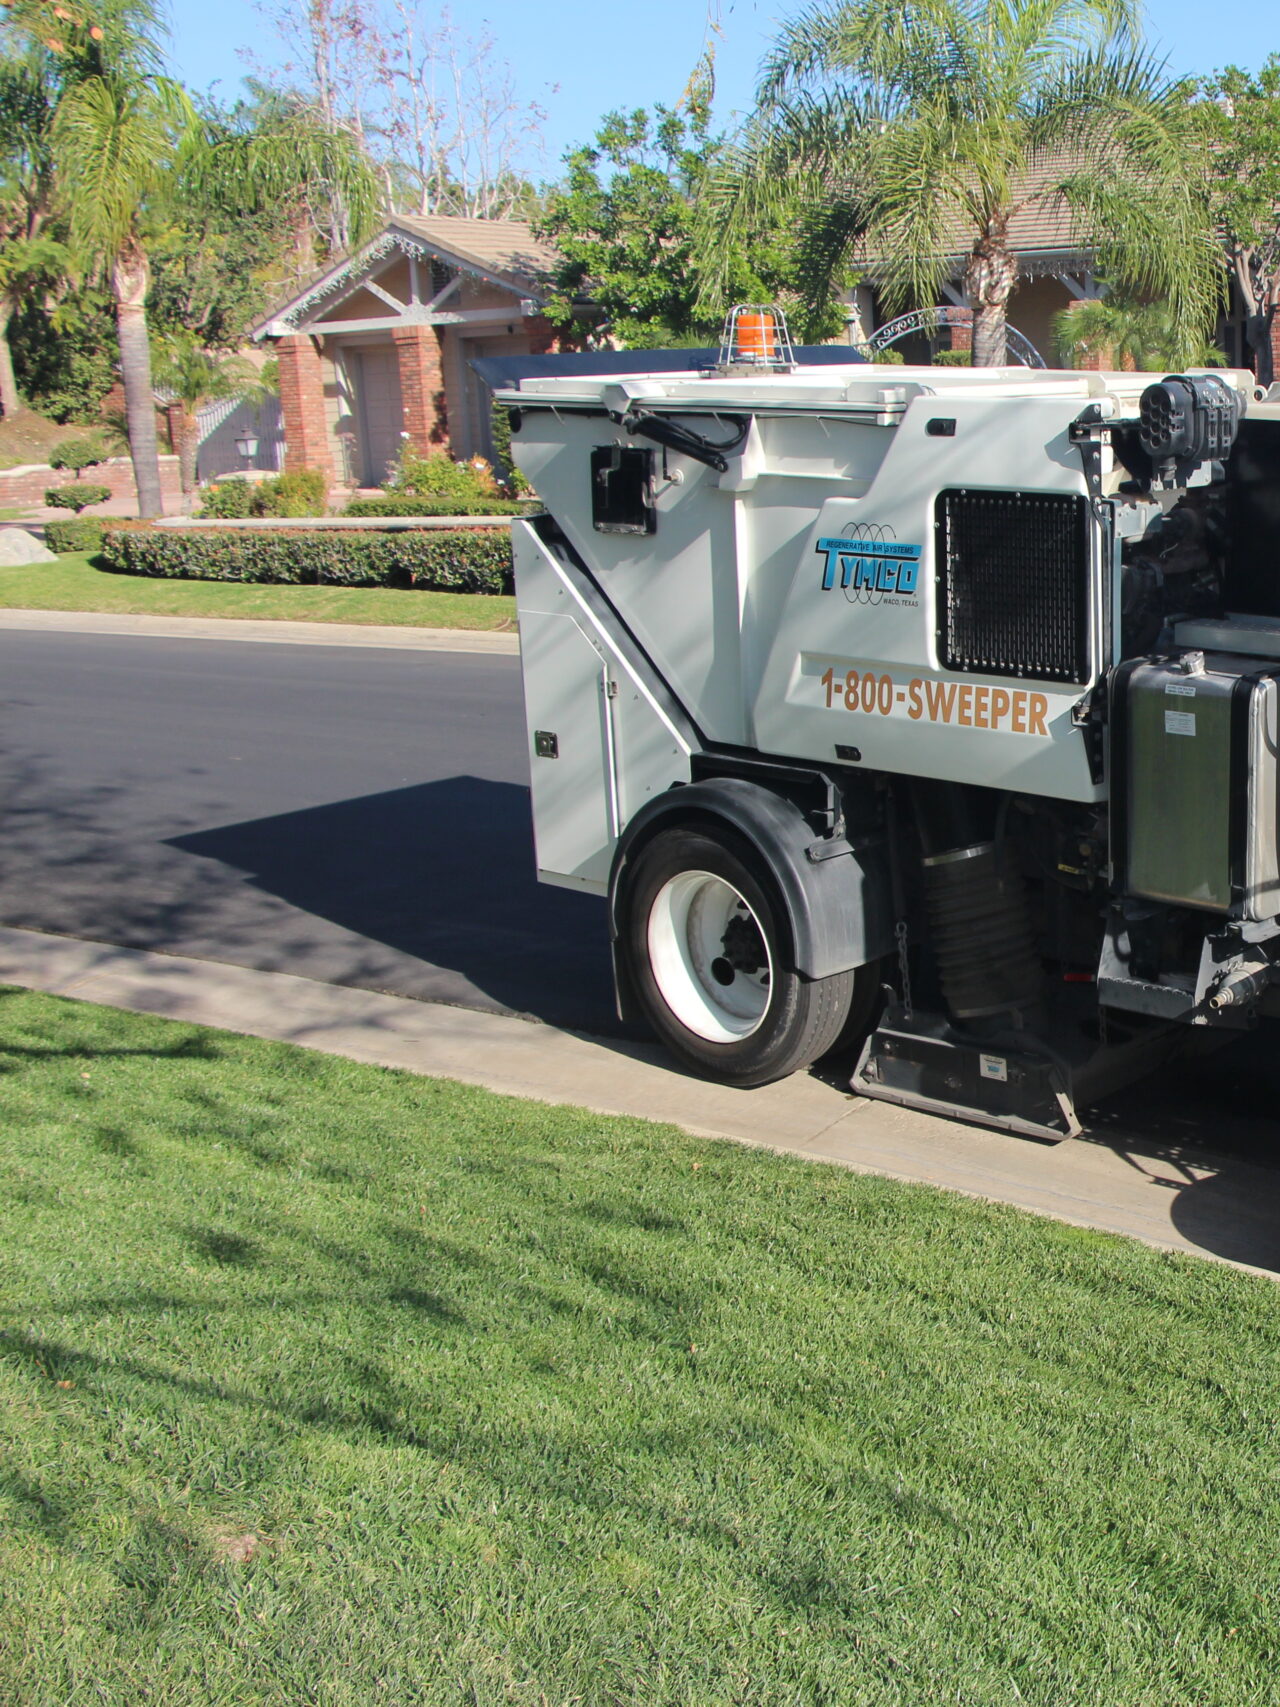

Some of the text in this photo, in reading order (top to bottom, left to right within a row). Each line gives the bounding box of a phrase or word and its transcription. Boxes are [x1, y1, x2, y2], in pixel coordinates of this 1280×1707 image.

[815, 537, 922, 595] TYMCO
[826, 540, 914, 554] REGENERATIVE AIR SYSTEMS
[821, 668, 1049, 736] 1-800-SWEEPER
